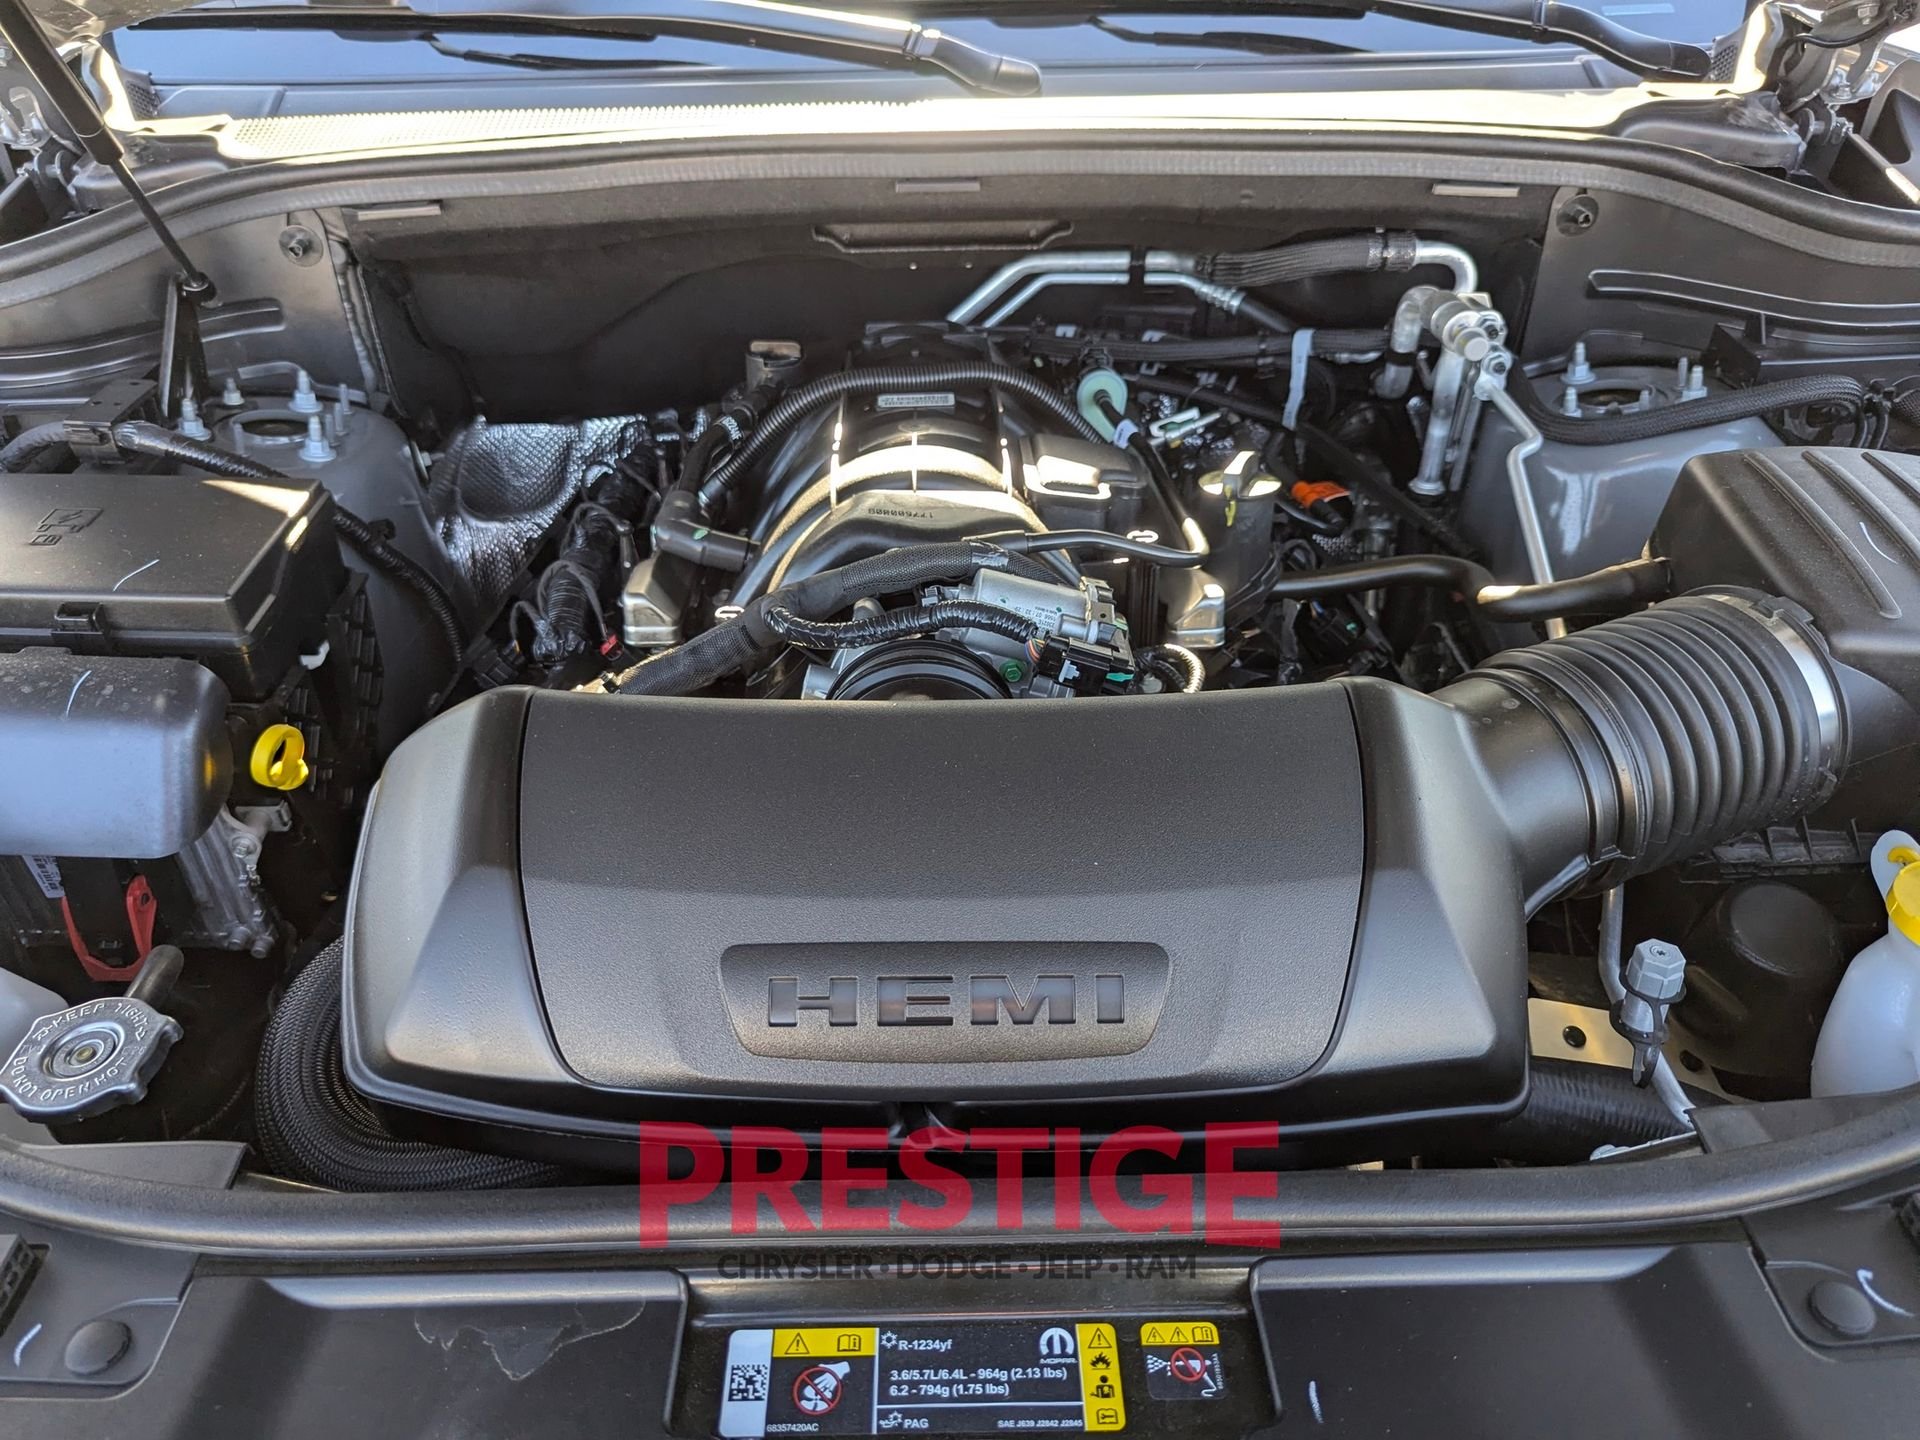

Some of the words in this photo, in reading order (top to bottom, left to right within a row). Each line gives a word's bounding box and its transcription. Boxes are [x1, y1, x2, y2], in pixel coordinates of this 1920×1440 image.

[768, 974, 1125, 1027] HEMI
[52, 1003, 105, 1028] KEEP
[11, 1056, 28, 1076] DO
[40, 1081, 90, 1101] OPEN
[94, 1057, 127, 1086] HOT
[898, 1339, 953, 1351] R-1234yf
[889, 1369, 968, 1381] 3.6/5.7L/6.4L
[977, 1368, 1008, 1381] 964g
[1010, 1367, 1041, 1381] (2.13
[1043, 1367, 1068, 1380] lbs)
[889, 1384, 909, 1396] 6.2
[919, 1384, 950, 1397] 794g
[952, 1383, 983, 1397] (1.75
[985, 1383, 1010, 1396] lbs)
[903, 1419, 929, 1428] PAG
[997, 1420, 1015, 1428] SAE
[1016, 1420, 1036, 1428] J639
